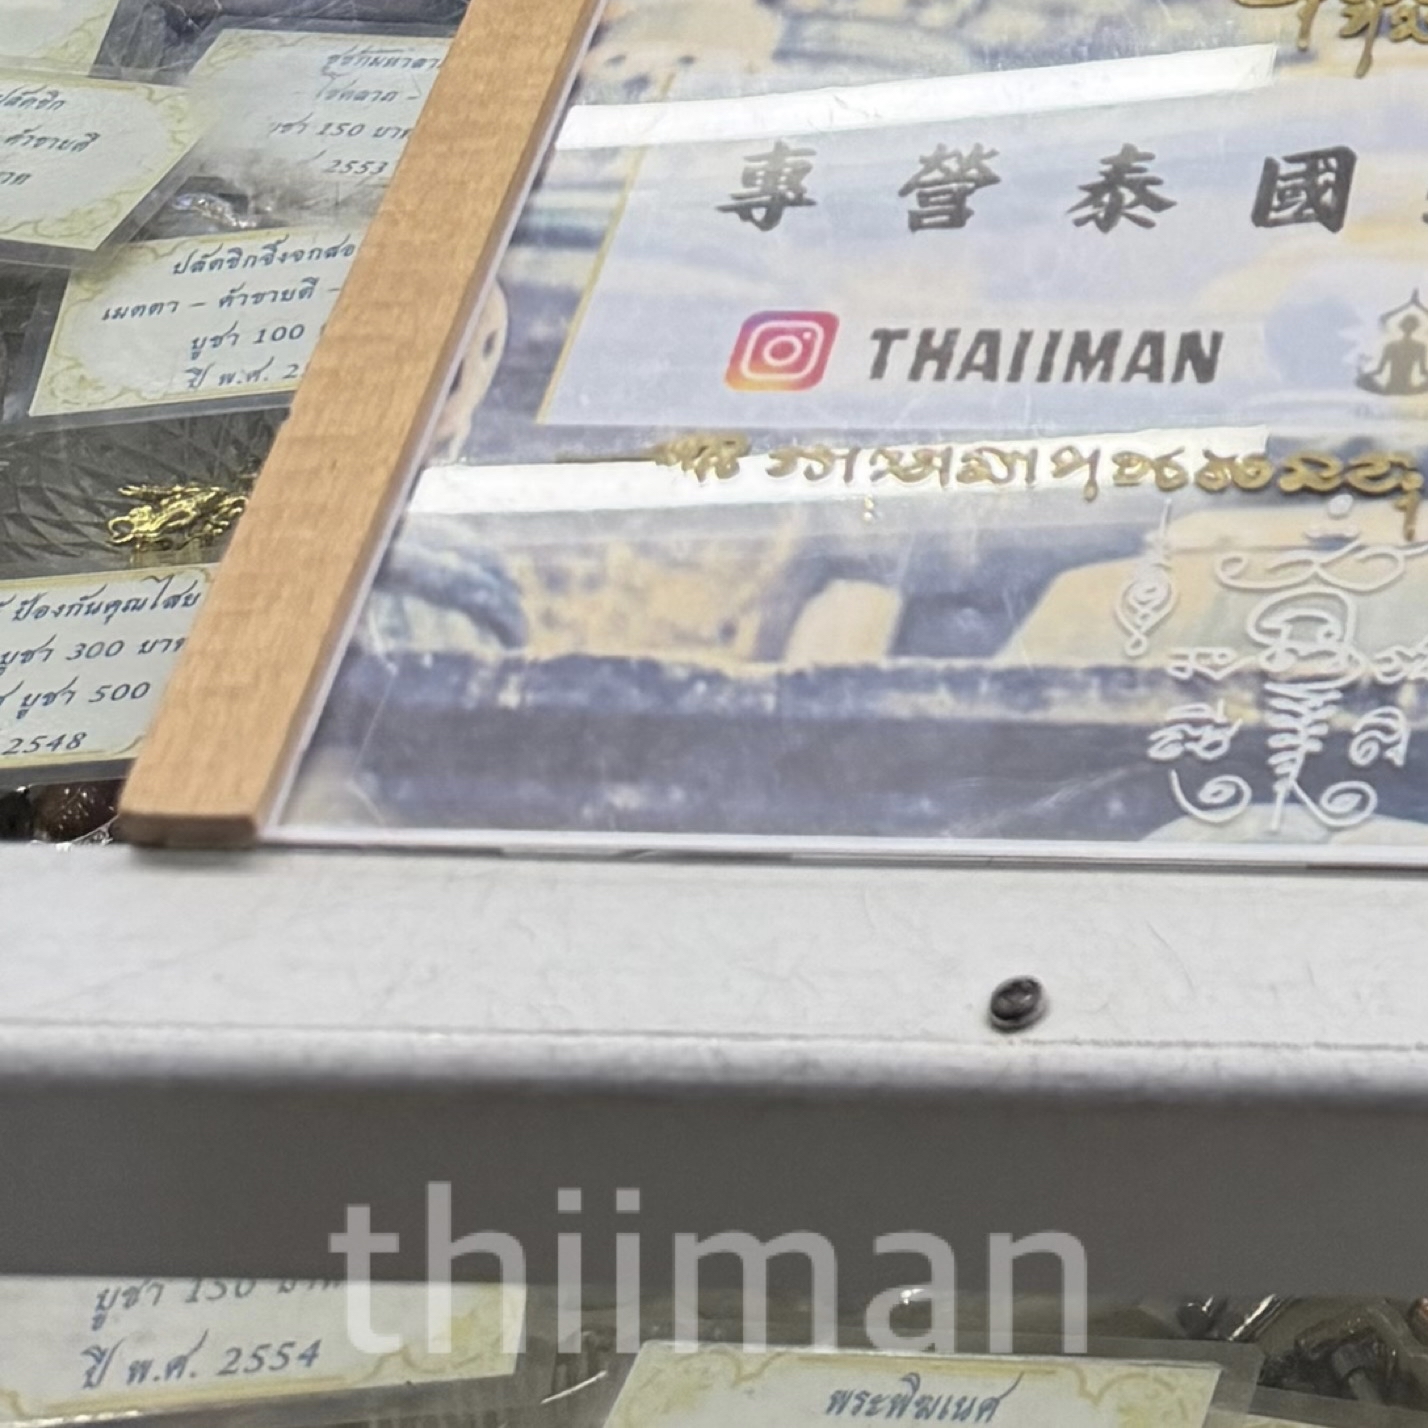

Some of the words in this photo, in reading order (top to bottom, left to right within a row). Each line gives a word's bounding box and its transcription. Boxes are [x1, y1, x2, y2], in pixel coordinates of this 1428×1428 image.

[316, 121, 368, 138] 150
[101, 298, 180, 321] เมตตา
[190, 320, 240, 360] บูชา
[254, 323, 306, 344] 100
[866, 327, 1228, 386] THAIIMAN
[185, 362, 211, 390] ปี
[217, 356, 275, 387] พ.ศ.
[65, 639, 126, 662] 300
[16, 676, 79, 720] บูชา
[88, 681, 152, 704] 500
[1, 730, 88, 757] 2548
[81, 1336, 125, 1391] ปี
[126, 1327, 210, 1387] พ.ศ.
[215, 1337, 323, 1377] 2554
